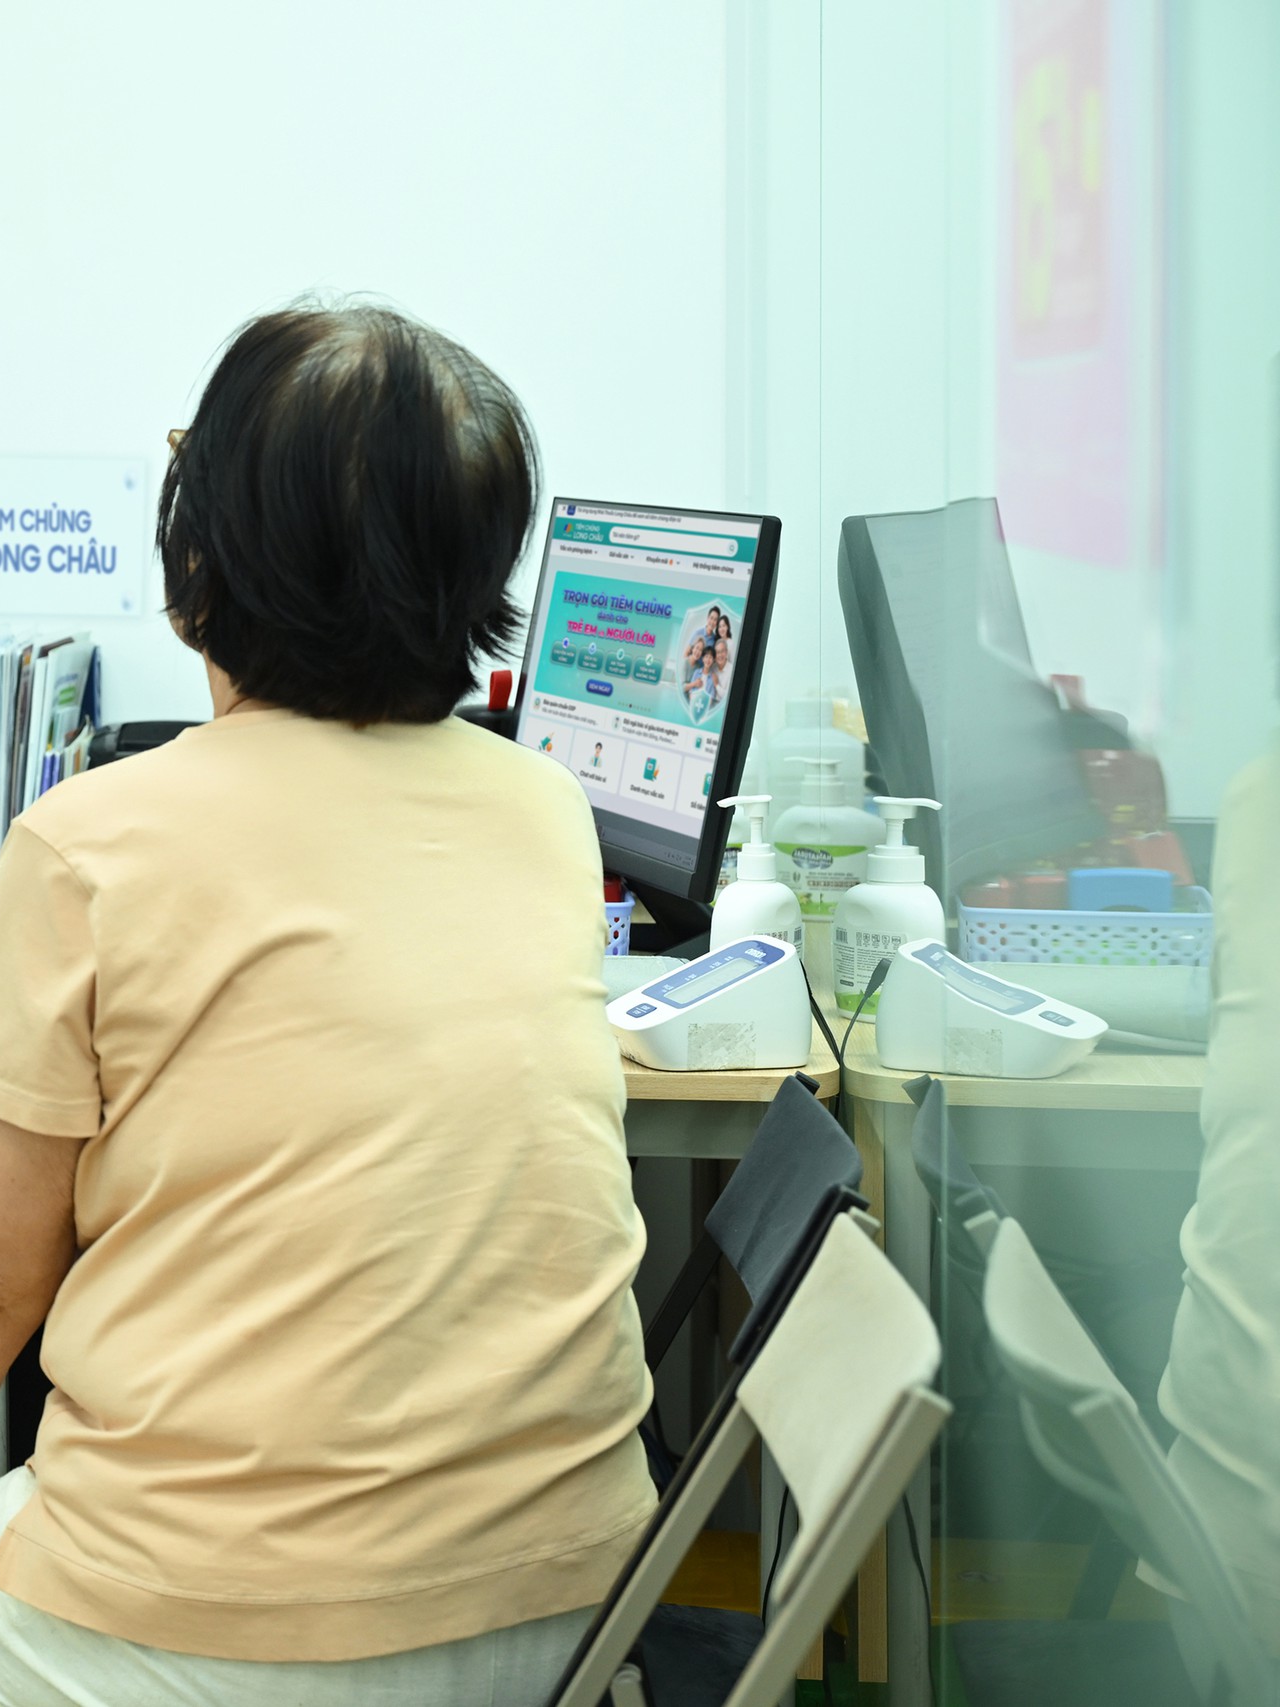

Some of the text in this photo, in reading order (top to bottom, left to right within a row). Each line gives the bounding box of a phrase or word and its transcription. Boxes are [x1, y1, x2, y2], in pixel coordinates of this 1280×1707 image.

[20, 502, 92, 533] CHỦNG
[47, 538, 117, 575] CHÂU
[563, 589, 672, 618] TRỌN GÓI TIÊM CHỦNG
[567, 618, 584, 634] TRẺ
[584, 624, 598, 636] EM
[606, 625, 635, 643] NGƯỜI
[636, 630, 656, 647] LỚN
